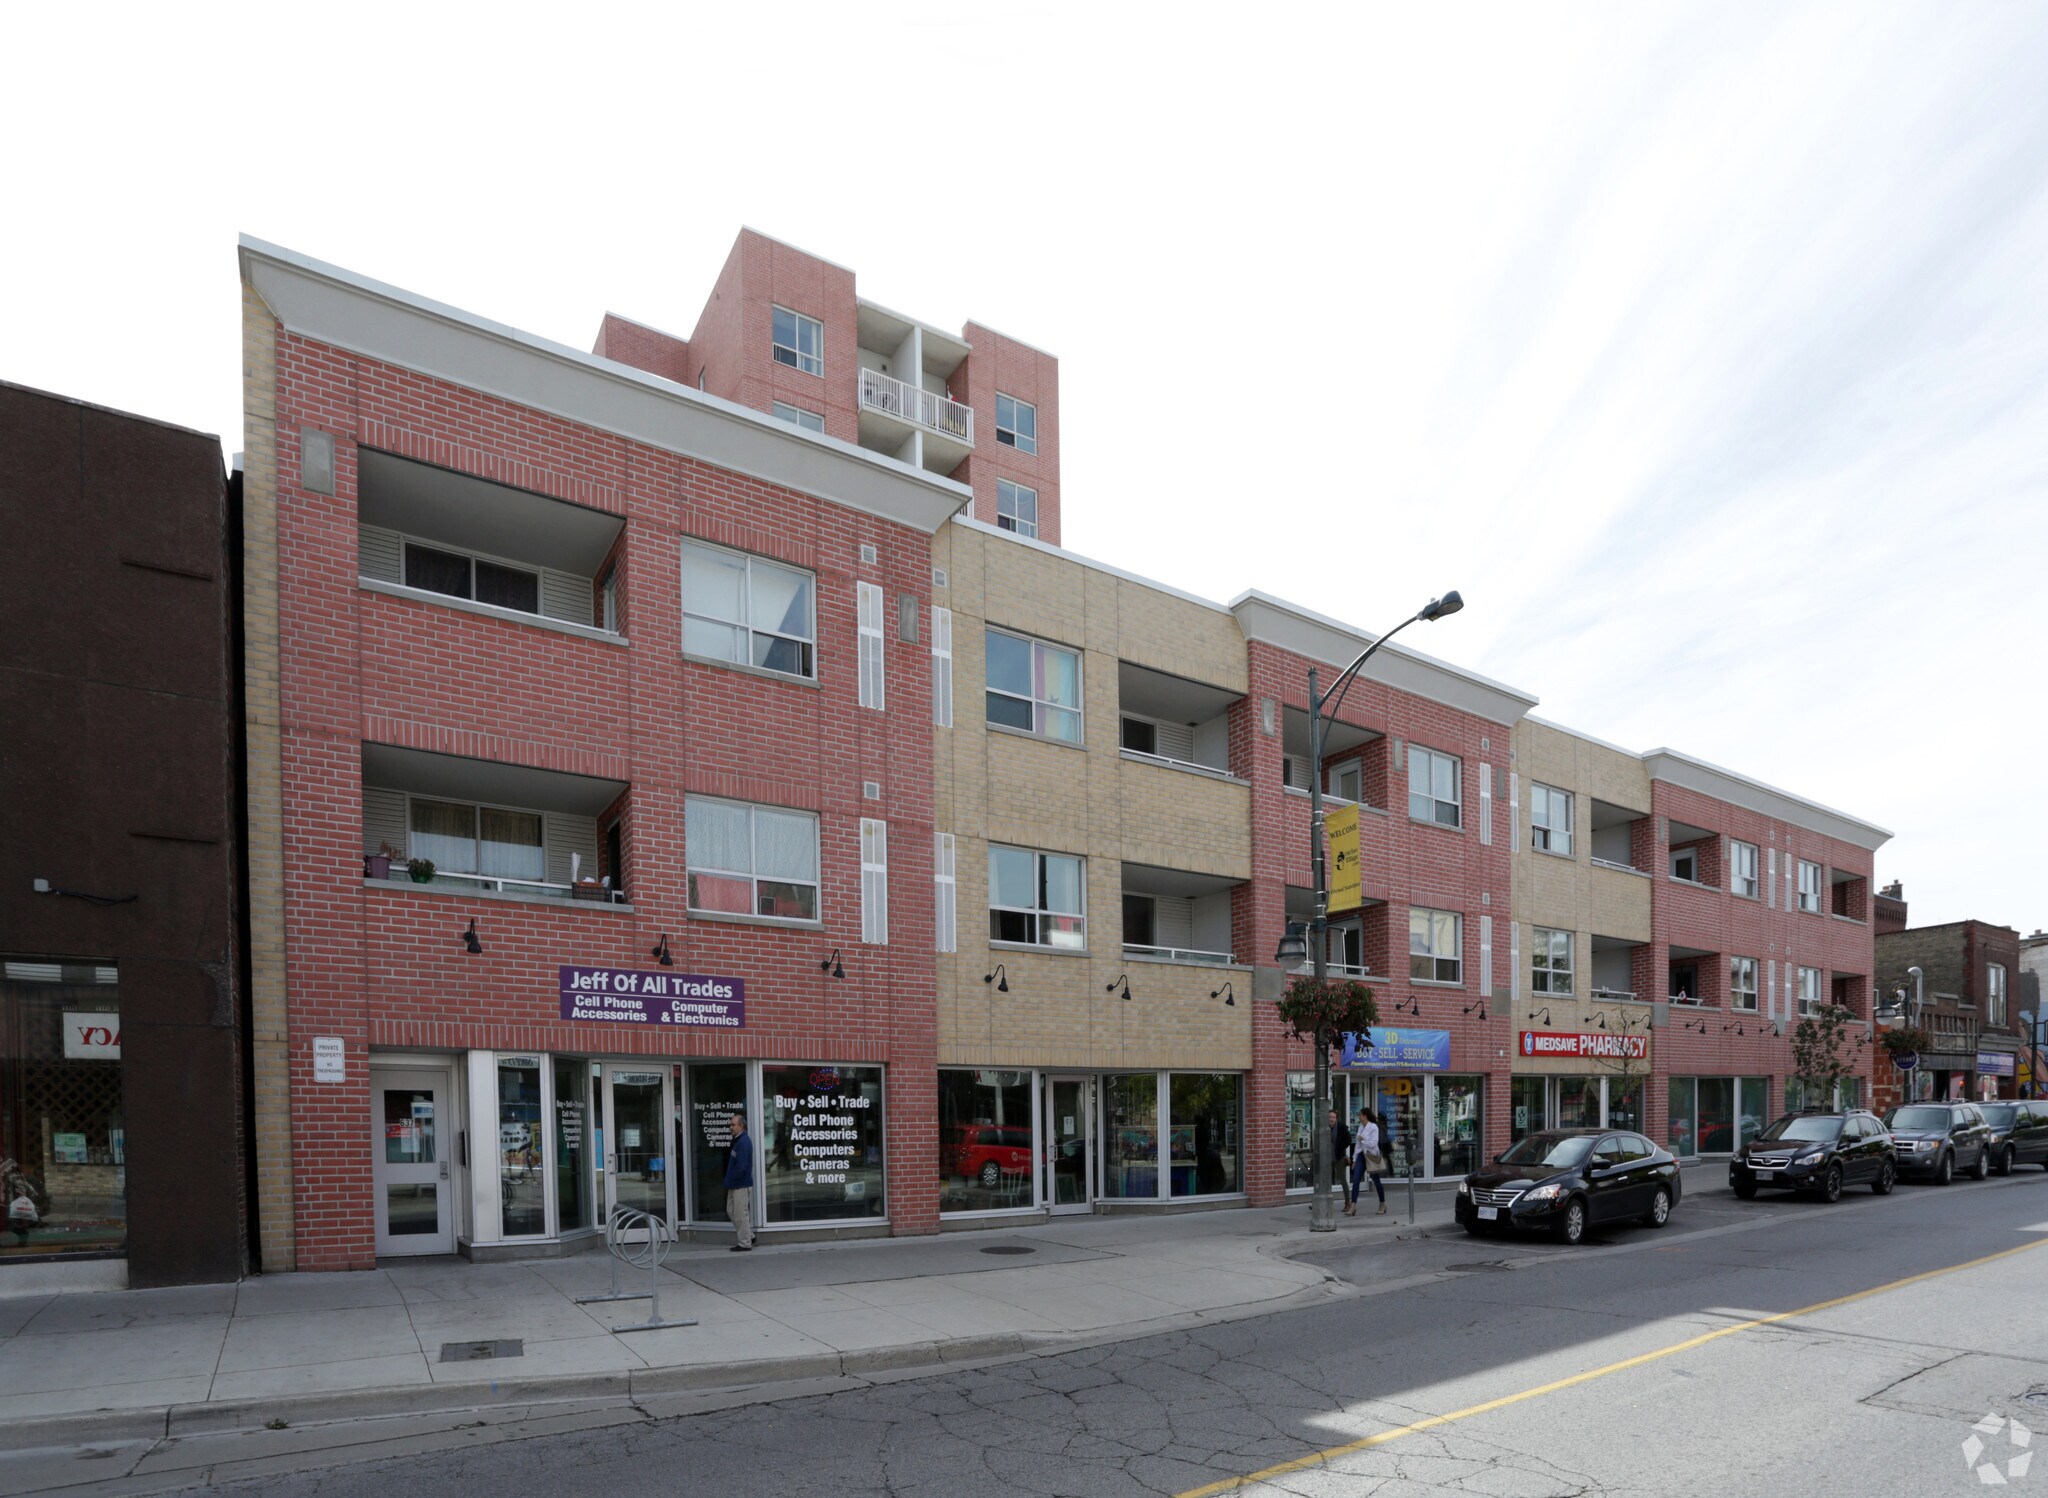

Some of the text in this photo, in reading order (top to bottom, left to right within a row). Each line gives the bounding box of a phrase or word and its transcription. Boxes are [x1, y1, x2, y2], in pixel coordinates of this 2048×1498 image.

[1330, 823, 1357, 839] WELCOME
[571, 971, 733, 998] Jeff Of All Trades
[575, 994, 643, 1009] Cell Phone
[672, 1000, 728, 1014] Computer
[572, 1007, 647, 1022] Accessories
[661, 1012, 739, 1026] & Electronics
[1385, 1031, 1398, 1044] 3D
[1535, 1035, 1646, 1057] MEDSAVE PHARMACY
[1379, 1047, 1398, 1059] SELL
[1403, 1048, 1435, 1060] SERVICE
[809, 1073, 841, 1086] OPEN
[1382, 1078, 1412, 1095] 3D
[694, 1103, 705, 1111] Buy
[775, 1095, 870, 1111] Buy Sell Trade
[400, 1119, 414, 1127] 637
[793, 1114, 854, 1126] Cell Phone
[791, 1128, 858, 1140] Accessories
[794, 1144, 855, 1158] Computers
[800, 1158, 850, 1171] Cameras
[805, 1171, 846, 1184] & more
